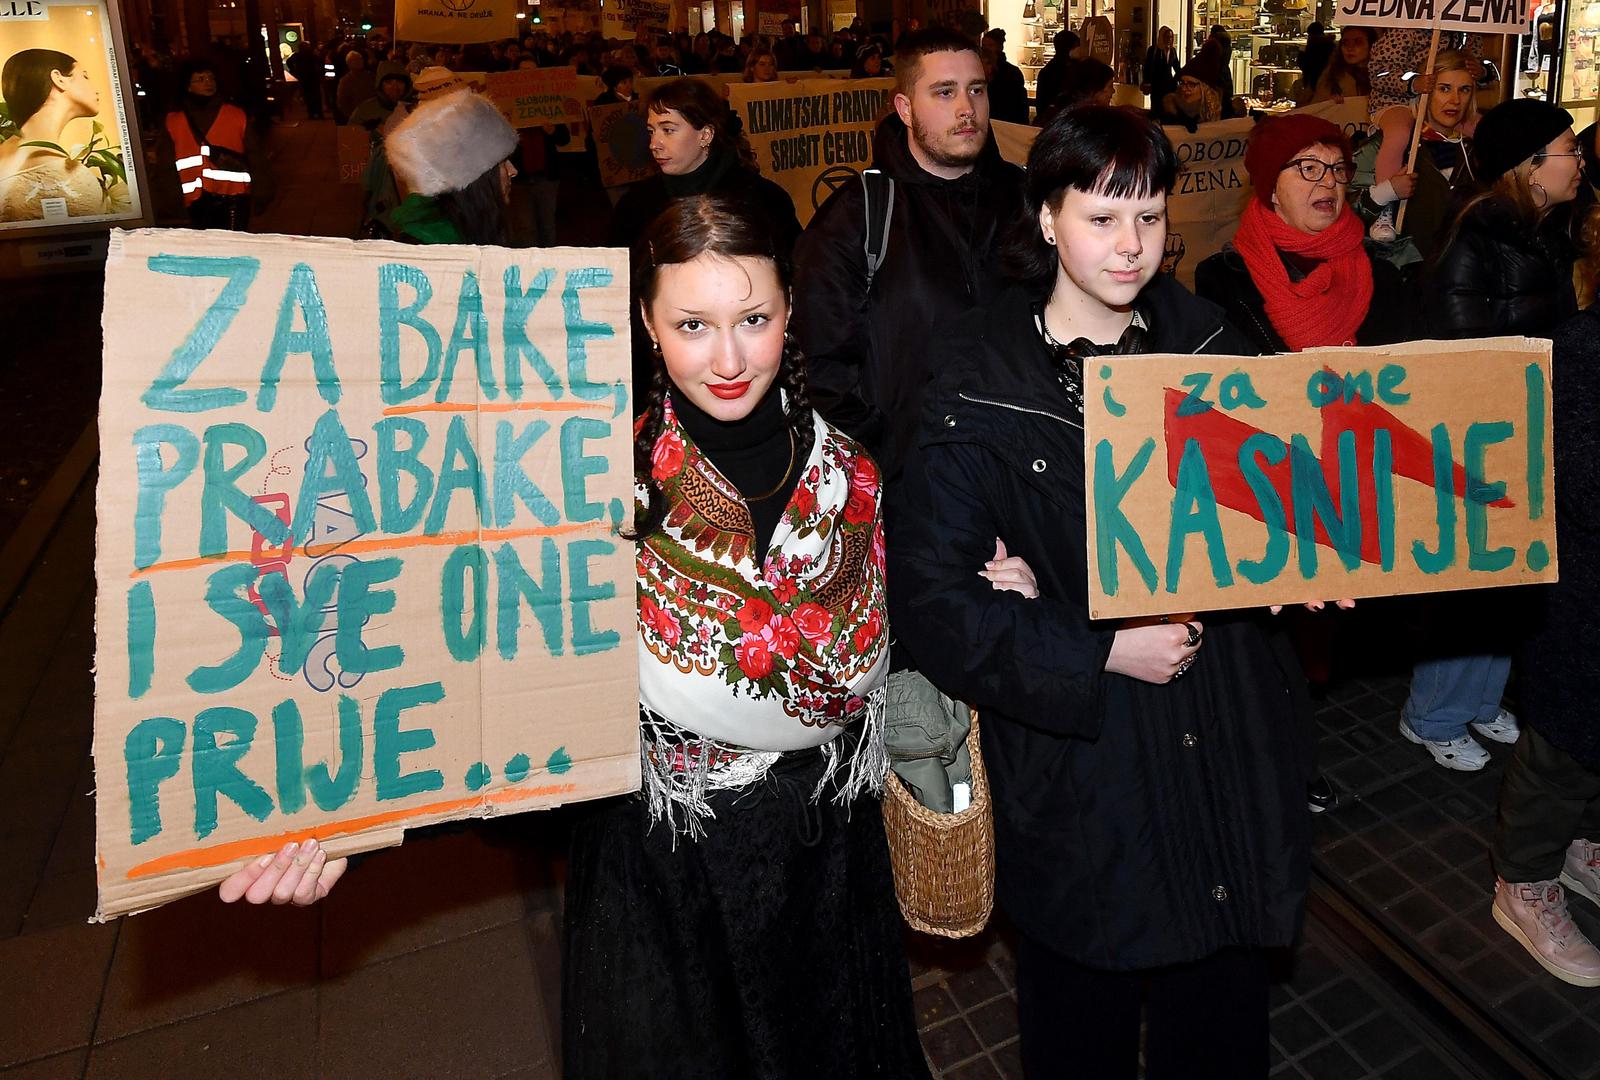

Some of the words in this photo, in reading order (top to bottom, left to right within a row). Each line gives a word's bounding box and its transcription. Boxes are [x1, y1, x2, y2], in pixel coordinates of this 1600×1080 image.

[747, 94, 830, 135] KLIMATSKA
[140, 253, 343, 413] ZA
[379, 263, 628, 418] BAKE,
[1100, 365, 1127, 417] i
[1175, 367, 1267, 416] za
[1307, 364, 1412, 408] one
[132, 409, 625, 570] PRABAKE,
[1093, 361, 1550, 597] KASNIJE!
[127, 580, 155, 699] I
[185, 557, 405, 694] SVE
[441, 537, 622, 662] ONE
[124, 681, 573, 846] PRIJE...
